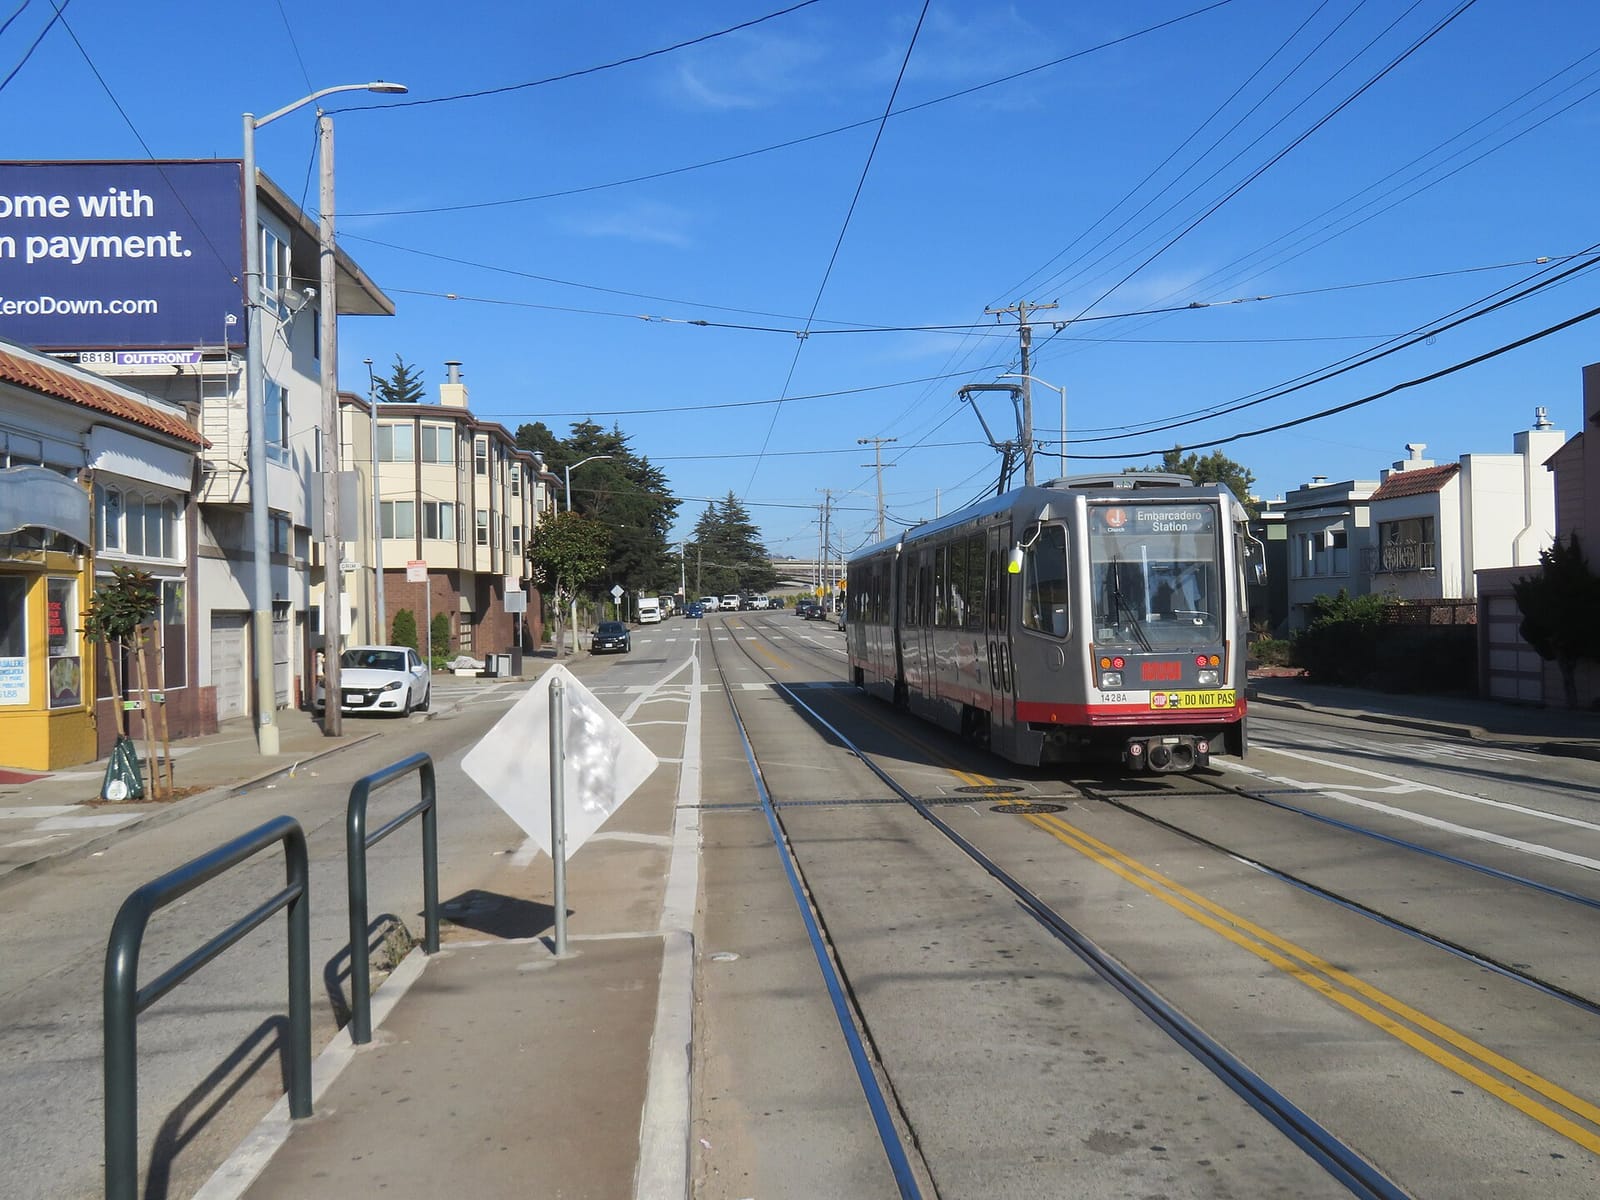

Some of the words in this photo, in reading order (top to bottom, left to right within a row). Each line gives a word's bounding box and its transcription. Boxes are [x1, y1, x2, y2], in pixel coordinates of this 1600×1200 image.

[78, 187, 154, 218] with
[26, 231, 192, 265] payment.
[81, 352, 112, 363] 6818
[123, 352, 194, 364] OUTFRONT
[1111, 508, 1120, 524] J
[1137, 511, 1202, 521] Embarcadero
[1152, 521, 1188, 532] Station
[1101, 693, 1127, 703] 1428A
[1185, 694, 1196, 705] DO
[1199, 693, 1215, 705] NOT
